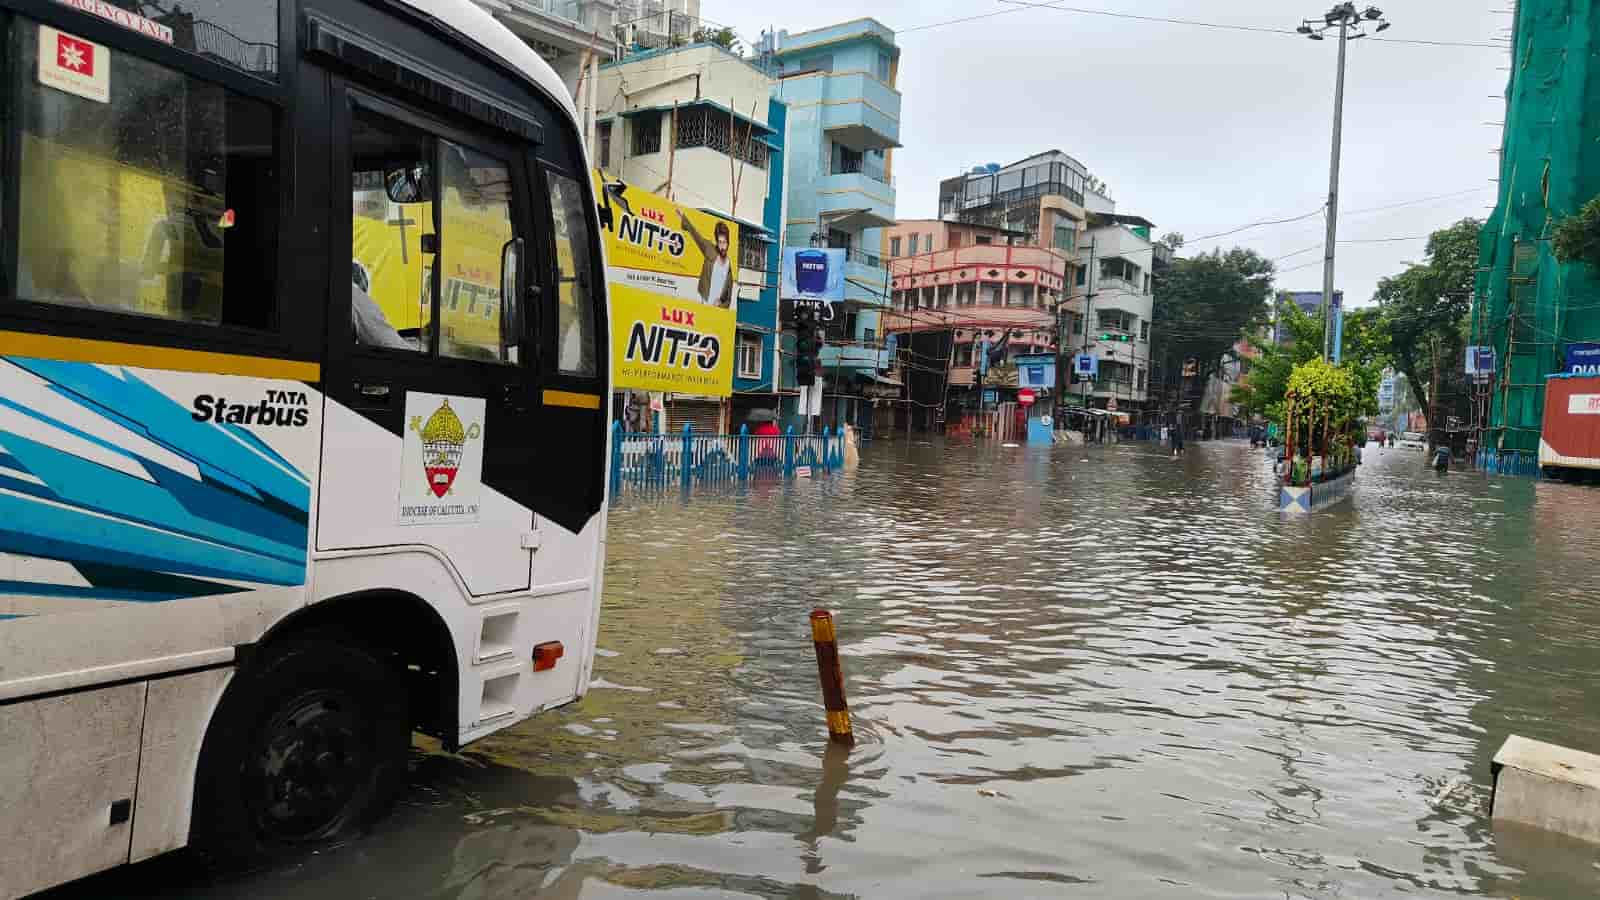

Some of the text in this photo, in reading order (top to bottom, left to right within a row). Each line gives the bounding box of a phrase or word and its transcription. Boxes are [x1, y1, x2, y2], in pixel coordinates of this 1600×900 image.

[641, 207, 665, 224] LUX
[618, 213, 686, 257] NITRO
[662, 306, 695, 326] LUX
[625, 321, 720, 370] NITRO
[265, 389, 308, 405] TATA
[191, 394, 309, 427] Starbus
